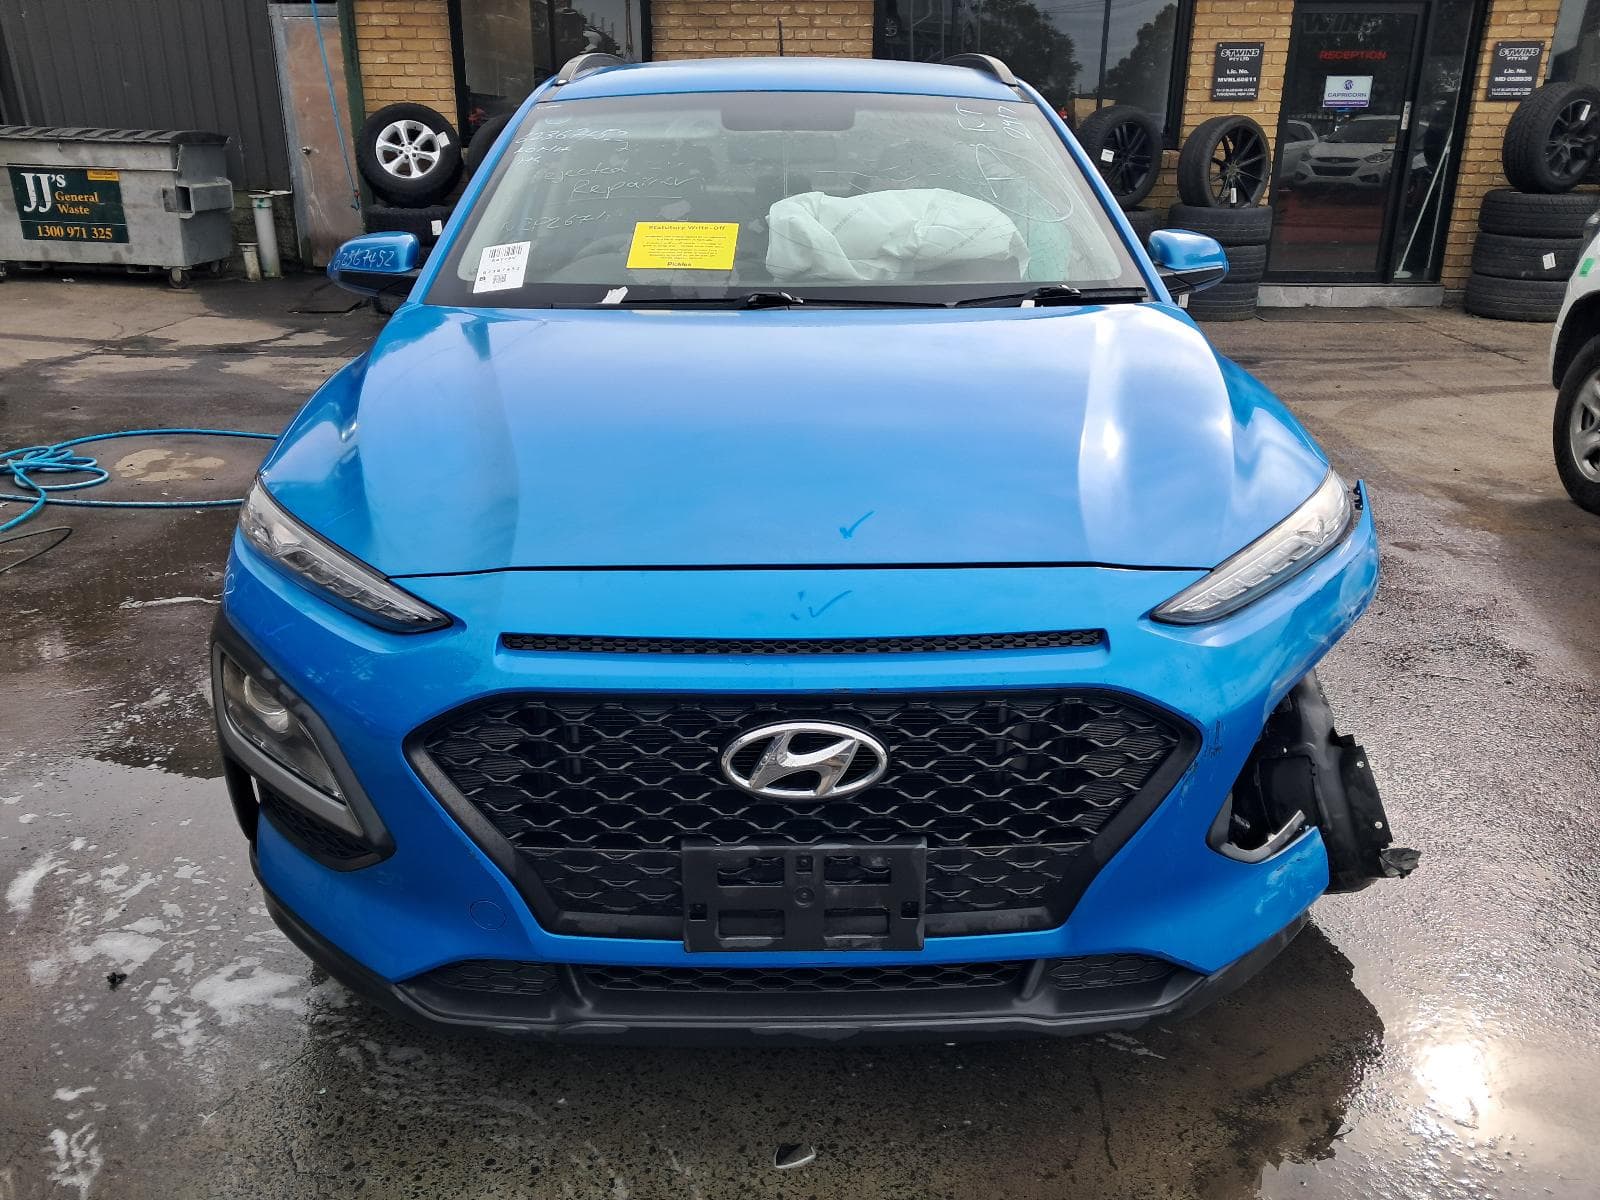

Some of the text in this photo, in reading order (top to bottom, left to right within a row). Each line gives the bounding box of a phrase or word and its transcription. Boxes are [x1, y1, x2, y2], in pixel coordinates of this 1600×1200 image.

[1319, 50, 1387, 60] RECEPTION
[54, 191, 99, 203] General
[56, 203, 90, 215] Waste
[37, 225, 113, 240] 1300 971 325
